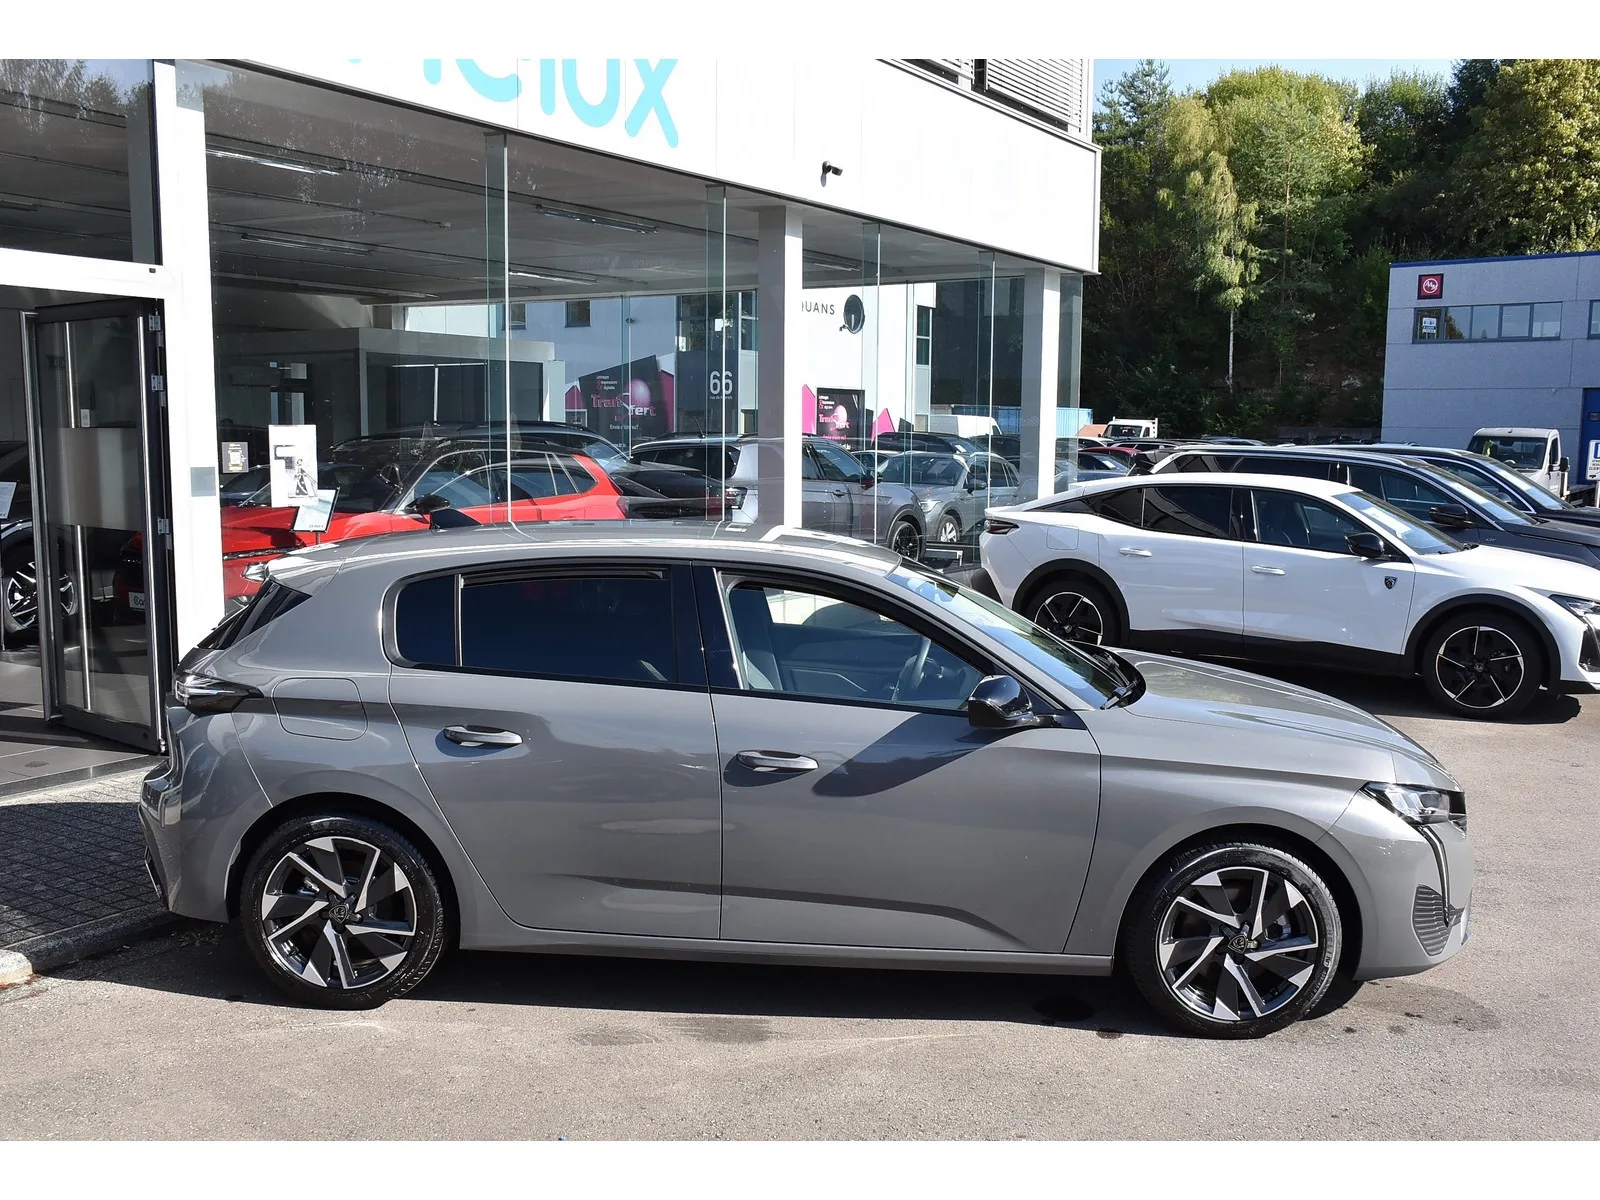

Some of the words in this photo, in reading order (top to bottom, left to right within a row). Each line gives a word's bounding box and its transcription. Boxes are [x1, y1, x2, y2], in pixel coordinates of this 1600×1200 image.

[801, 301, 836, 315] UANS
[710, 370, 733, 395] 66
[133, 595, 146, 606] Ca
